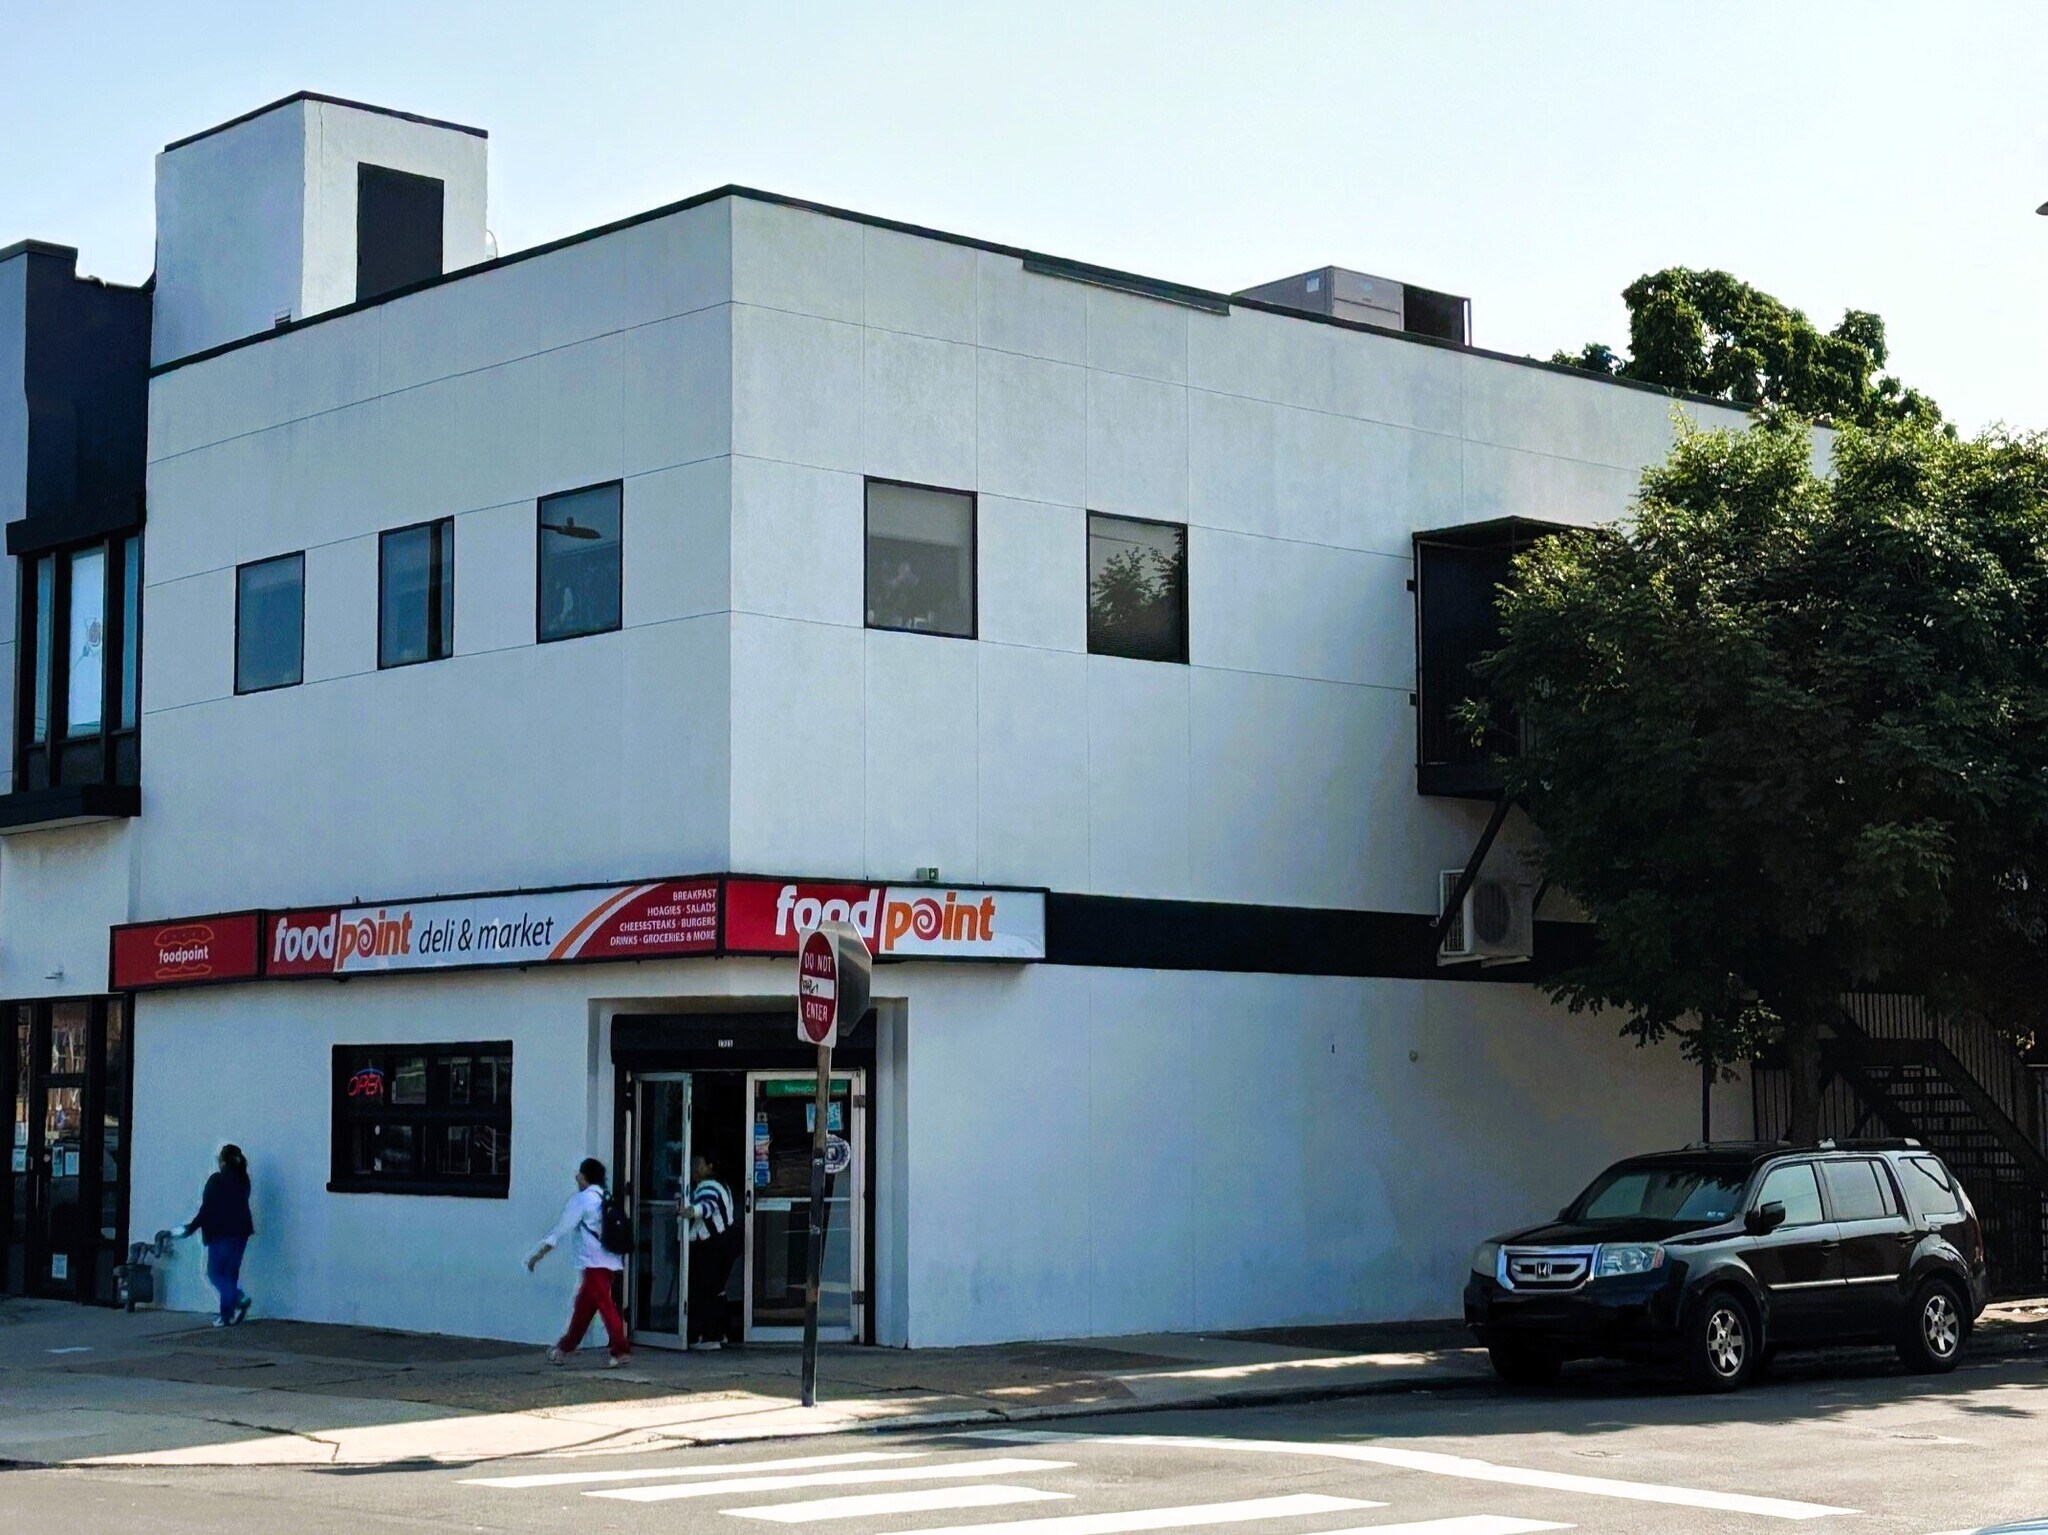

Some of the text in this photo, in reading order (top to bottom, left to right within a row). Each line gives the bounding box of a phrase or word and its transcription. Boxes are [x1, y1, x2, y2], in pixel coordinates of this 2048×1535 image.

[672, 888, 717, 901] BREAKFAST
[647, 902, 716, 917] HOAGIES SALADS
[419, 919, 456, 954] deli
[458, 925, 474, 951] &
[476, 911, 555, 950] market
[619, 916, 716, 932] CHEESESTEAKS BURGERS
[610, 935, 638, 947] DRINKS
[643, 932, 685, 944] GROCERIES
[692, 930, 716, 941] MORE
[157, 946, 209, 964] foodpoint
[804, 952, 833, 973] DO NOT
[806, 1001, 829, 1023] ENTER
[348, 1075, 383, 1097] OPEN
